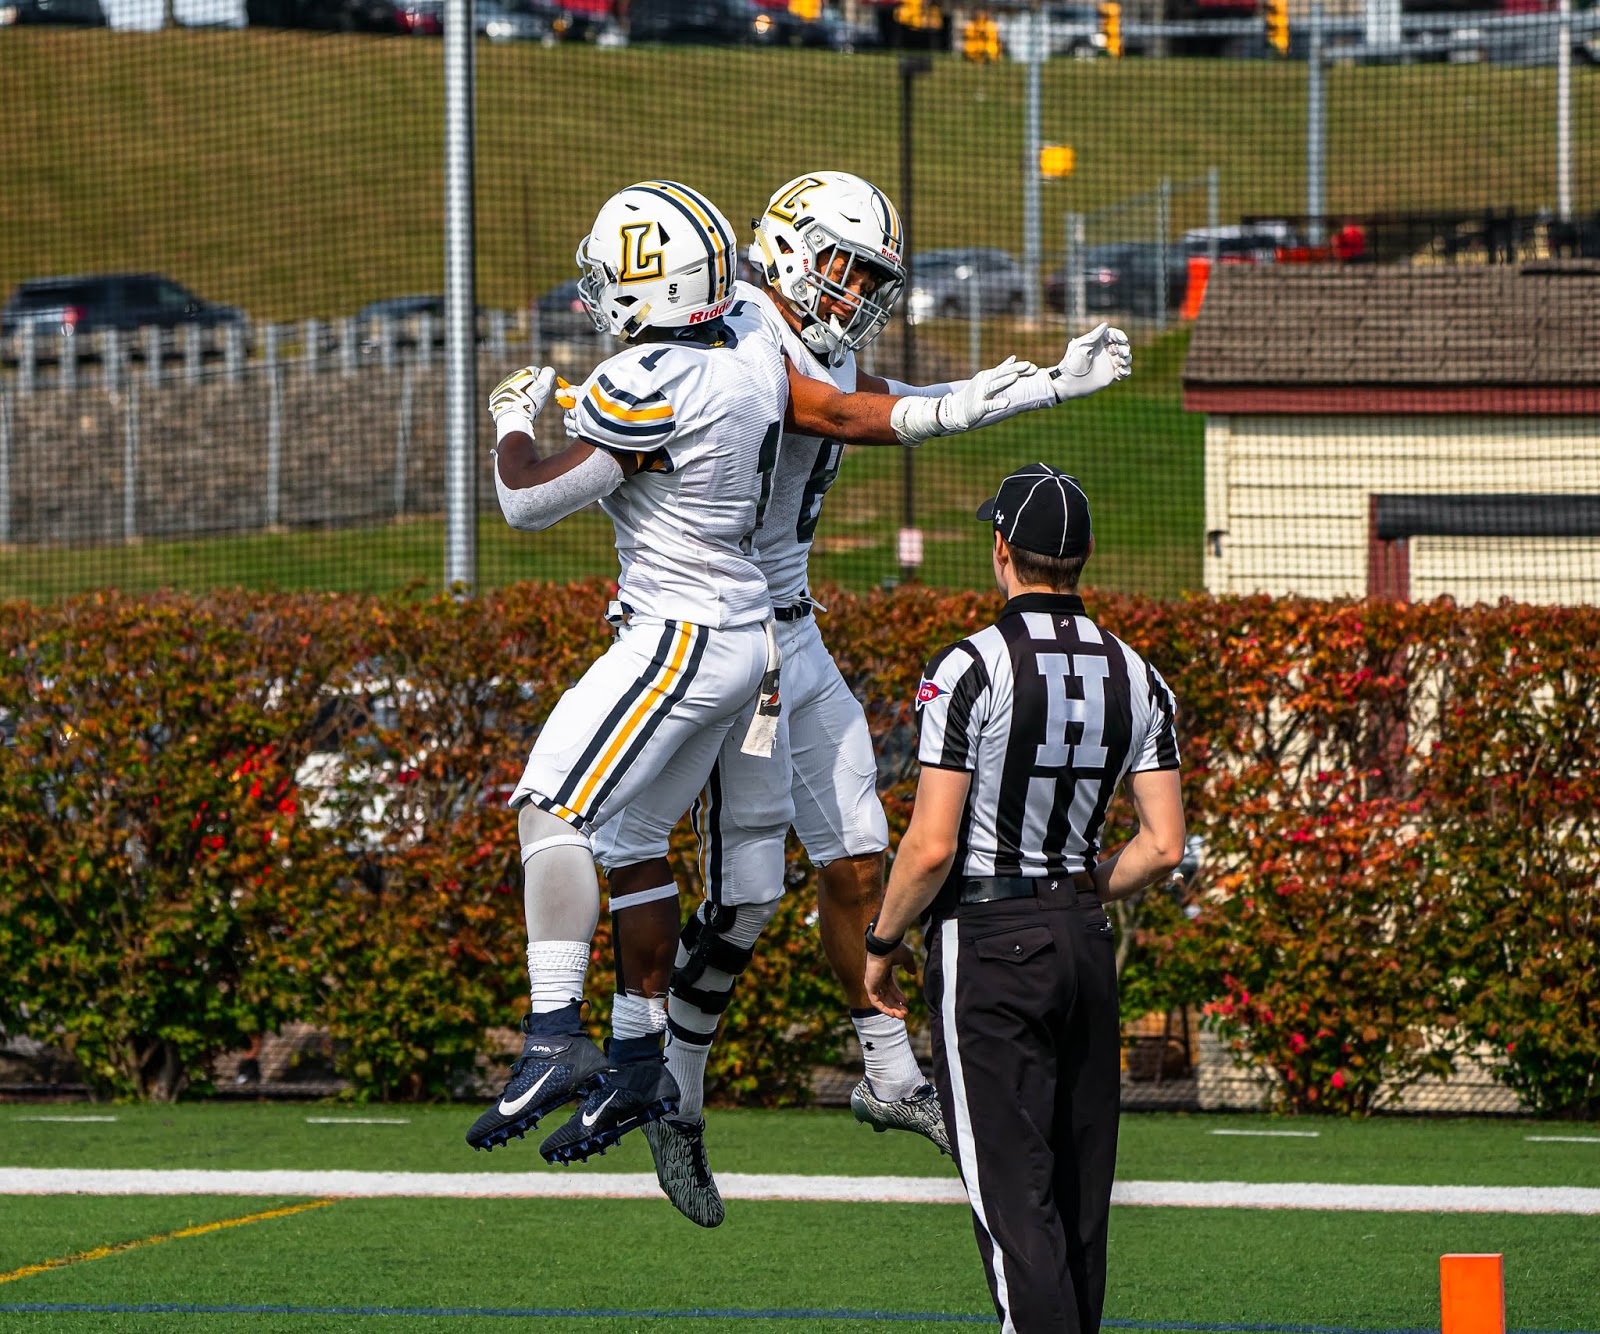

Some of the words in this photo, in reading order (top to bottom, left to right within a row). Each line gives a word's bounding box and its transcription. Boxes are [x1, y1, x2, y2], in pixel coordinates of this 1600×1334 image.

[767, 178, 826, 225] L
[619, 222, 665, 285] L
[1034, 653, 1110, 768] H
[531, 1045, 552, 1053] ALPHA
